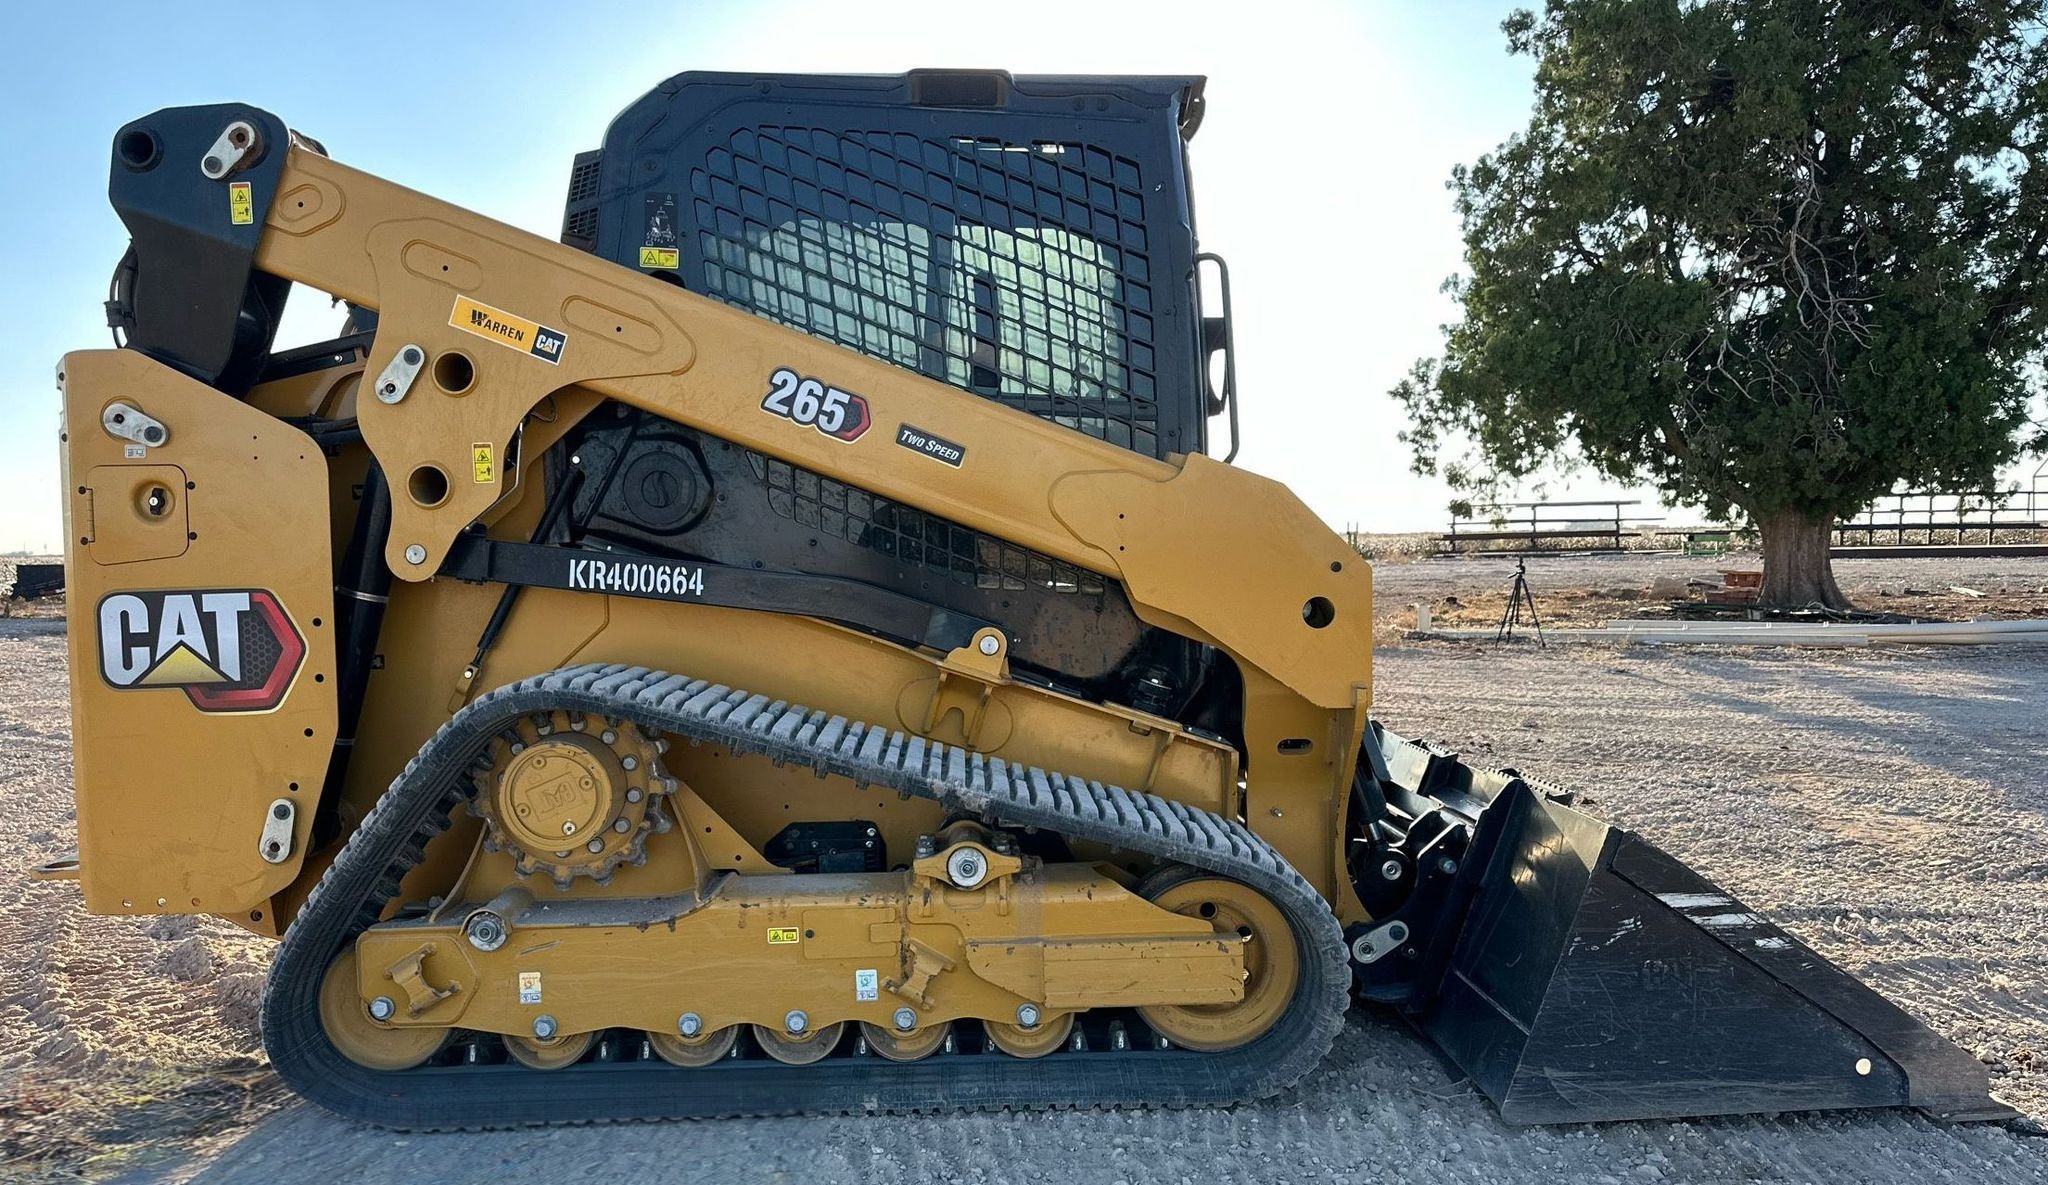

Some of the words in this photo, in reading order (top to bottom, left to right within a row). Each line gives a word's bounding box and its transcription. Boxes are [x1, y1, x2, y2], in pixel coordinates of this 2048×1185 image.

[470, 309, 525, 342] WARREN
[535, 334, 562, 355] CAT
[764, 370, 850, 432] 265
[568, 558, 704, 596] KR400664
[100, 592, 250, 685] CAT
